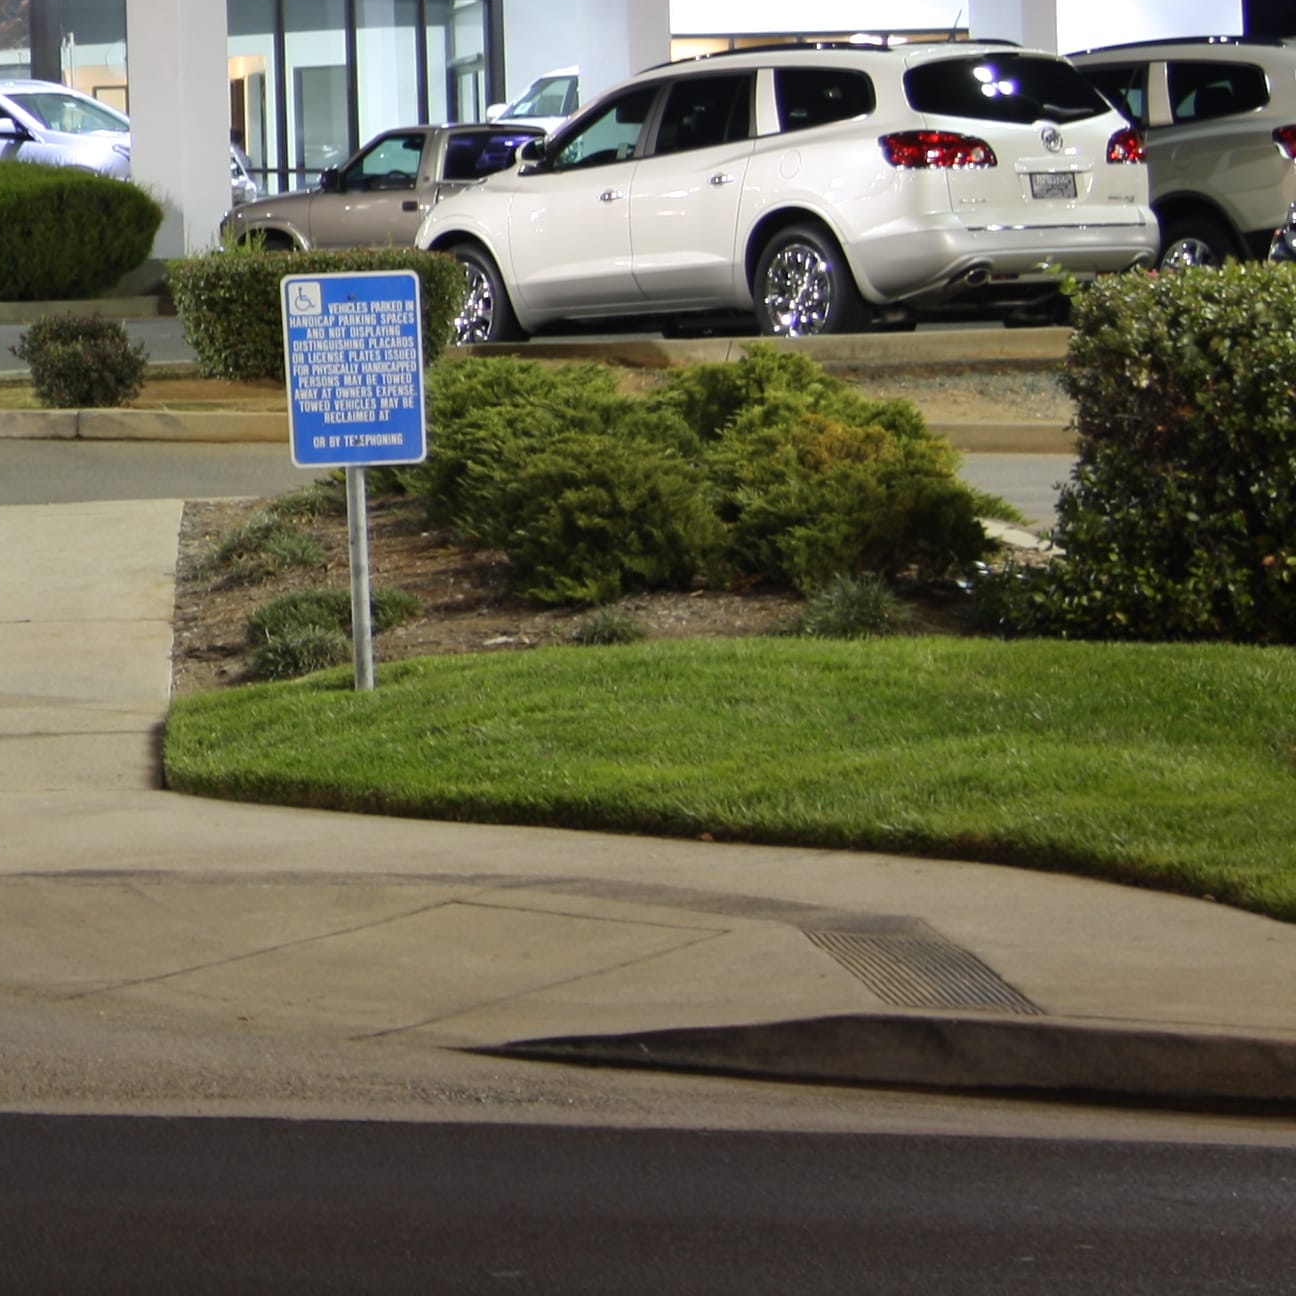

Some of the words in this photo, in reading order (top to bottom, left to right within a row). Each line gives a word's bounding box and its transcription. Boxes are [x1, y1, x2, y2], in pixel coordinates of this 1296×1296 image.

[328, 302, 368, 315] VEHICLES
[370, 300, 403, 313] PARKED
[405, 299, 414, 311] IN
[289, 315, 335, 328] HANDICAP
[338, 313, 376, 326] PARKING
[380, 312, 414, 324] SPACES
[306, 327, 325, 339] AND
[329, 326, 346, 338] NOT
[350, 324, 401, 337] DISPLAYING
[293, 338, 365, 352] DISTINGUISHING
[368, 336, 414, 349] PLACARDS
[292, 352, 304, 364] OR
[308, 351, 345, 364] LICENSE
[349, 350, 381, 362] PLATES
[385, 348, 416, 361] ISSUED
[293, 364, 309, 376] FOR
[312, 363, 358, 376] PHYSICALLY
[362, 361, 416, 374] HANDICAPPED
[298, 375, 340, 388] PERSONS
[344, 375, 362, 386] MAY
[366, 374, 377, 385] BE
[382, 373, 412, 384] TOWED
[294, 388, 318, 400] AWAY
[321, 387, 332, 399] AT
[335, 386, 372, 398] OWNERS
[300, 400, 330, 413] TOWED
[334, 398, 376, 411] VEHICLES
[380, 397, 399, 409] MAY
[402, 396, 414, 408] BE
[324, 410, 375, 424] RECLAIMED
[379, 409, 390, 422] AT
[313, 435, 326, 448] OR
[329, 435, 341, 447] BY
